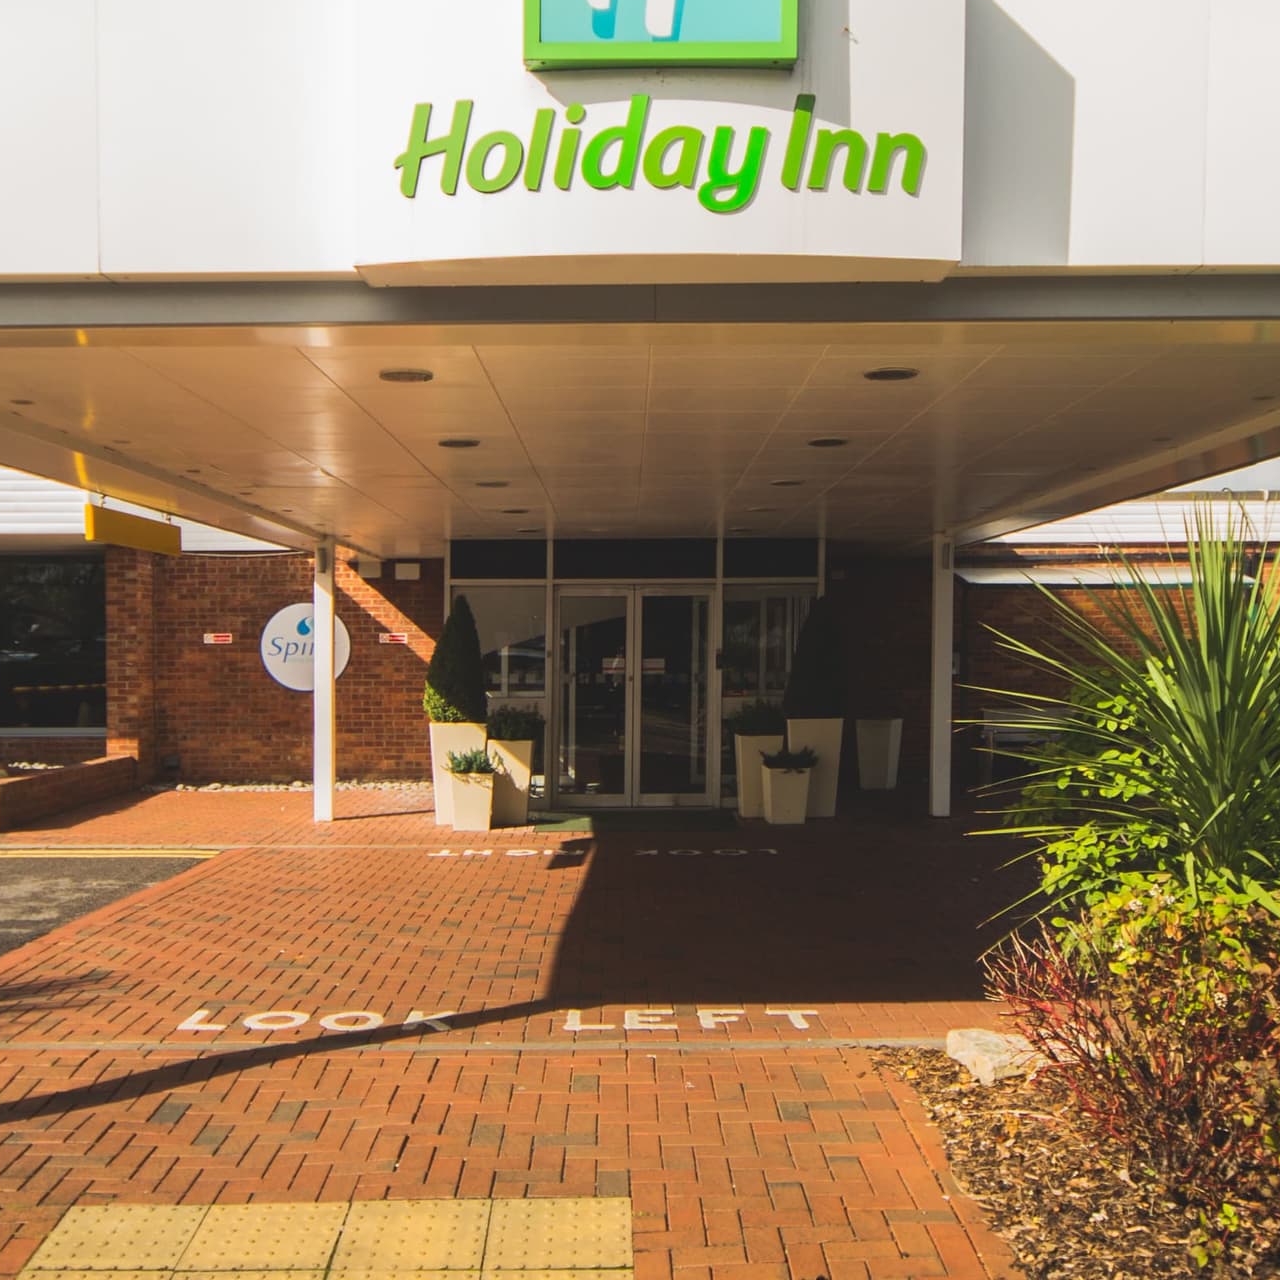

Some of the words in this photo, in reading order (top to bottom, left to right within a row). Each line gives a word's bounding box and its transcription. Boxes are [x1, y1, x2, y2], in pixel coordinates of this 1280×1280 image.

[394, 94, 770, 213] Holiday
[780, 94, 926, 195] Inn
[178, 1010, 453, 1031] LOOK
[563, 1009, 820, 1031] LEFT
